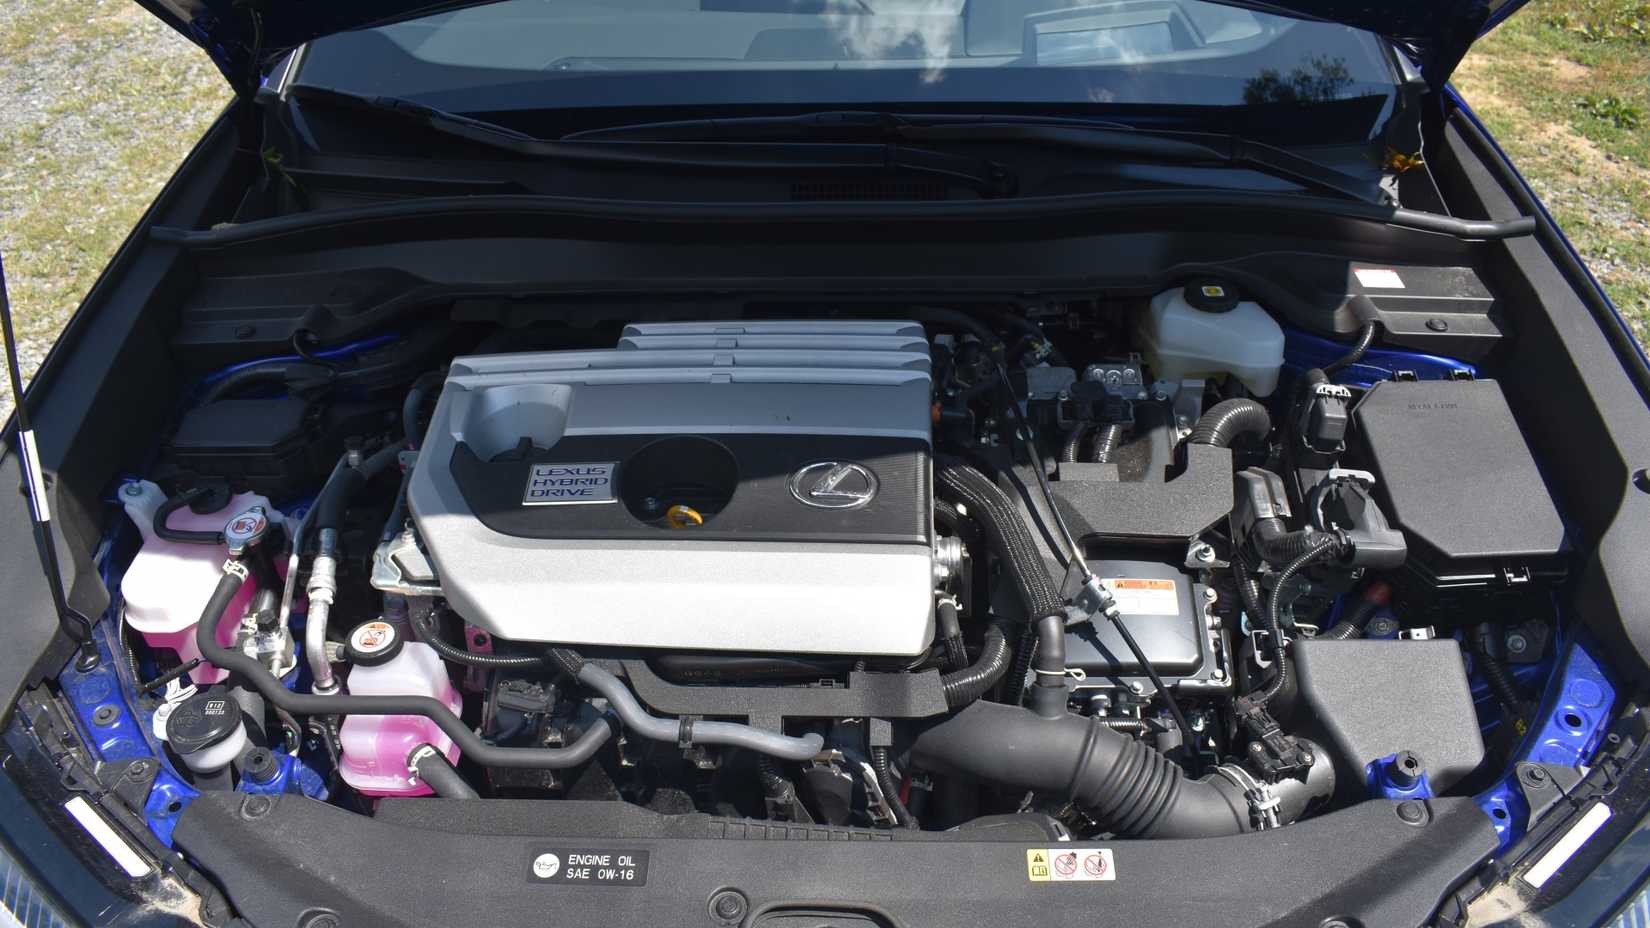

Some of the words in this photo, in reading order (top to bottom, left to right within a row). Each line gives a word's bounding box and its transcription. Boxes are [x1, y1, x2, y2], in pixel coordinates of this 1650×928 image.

[536, 467, 607, 476] LEXUS
[533, 478, 609, 487] HYBRID
[530, 488, 593, 497] DRIVE
[568, 855, 610, 865] ENGINE
[618, 855, 636, 866] OIL
[566, 868, 590, 879] SAE
[598, 869, 634, 880] 0W-16
